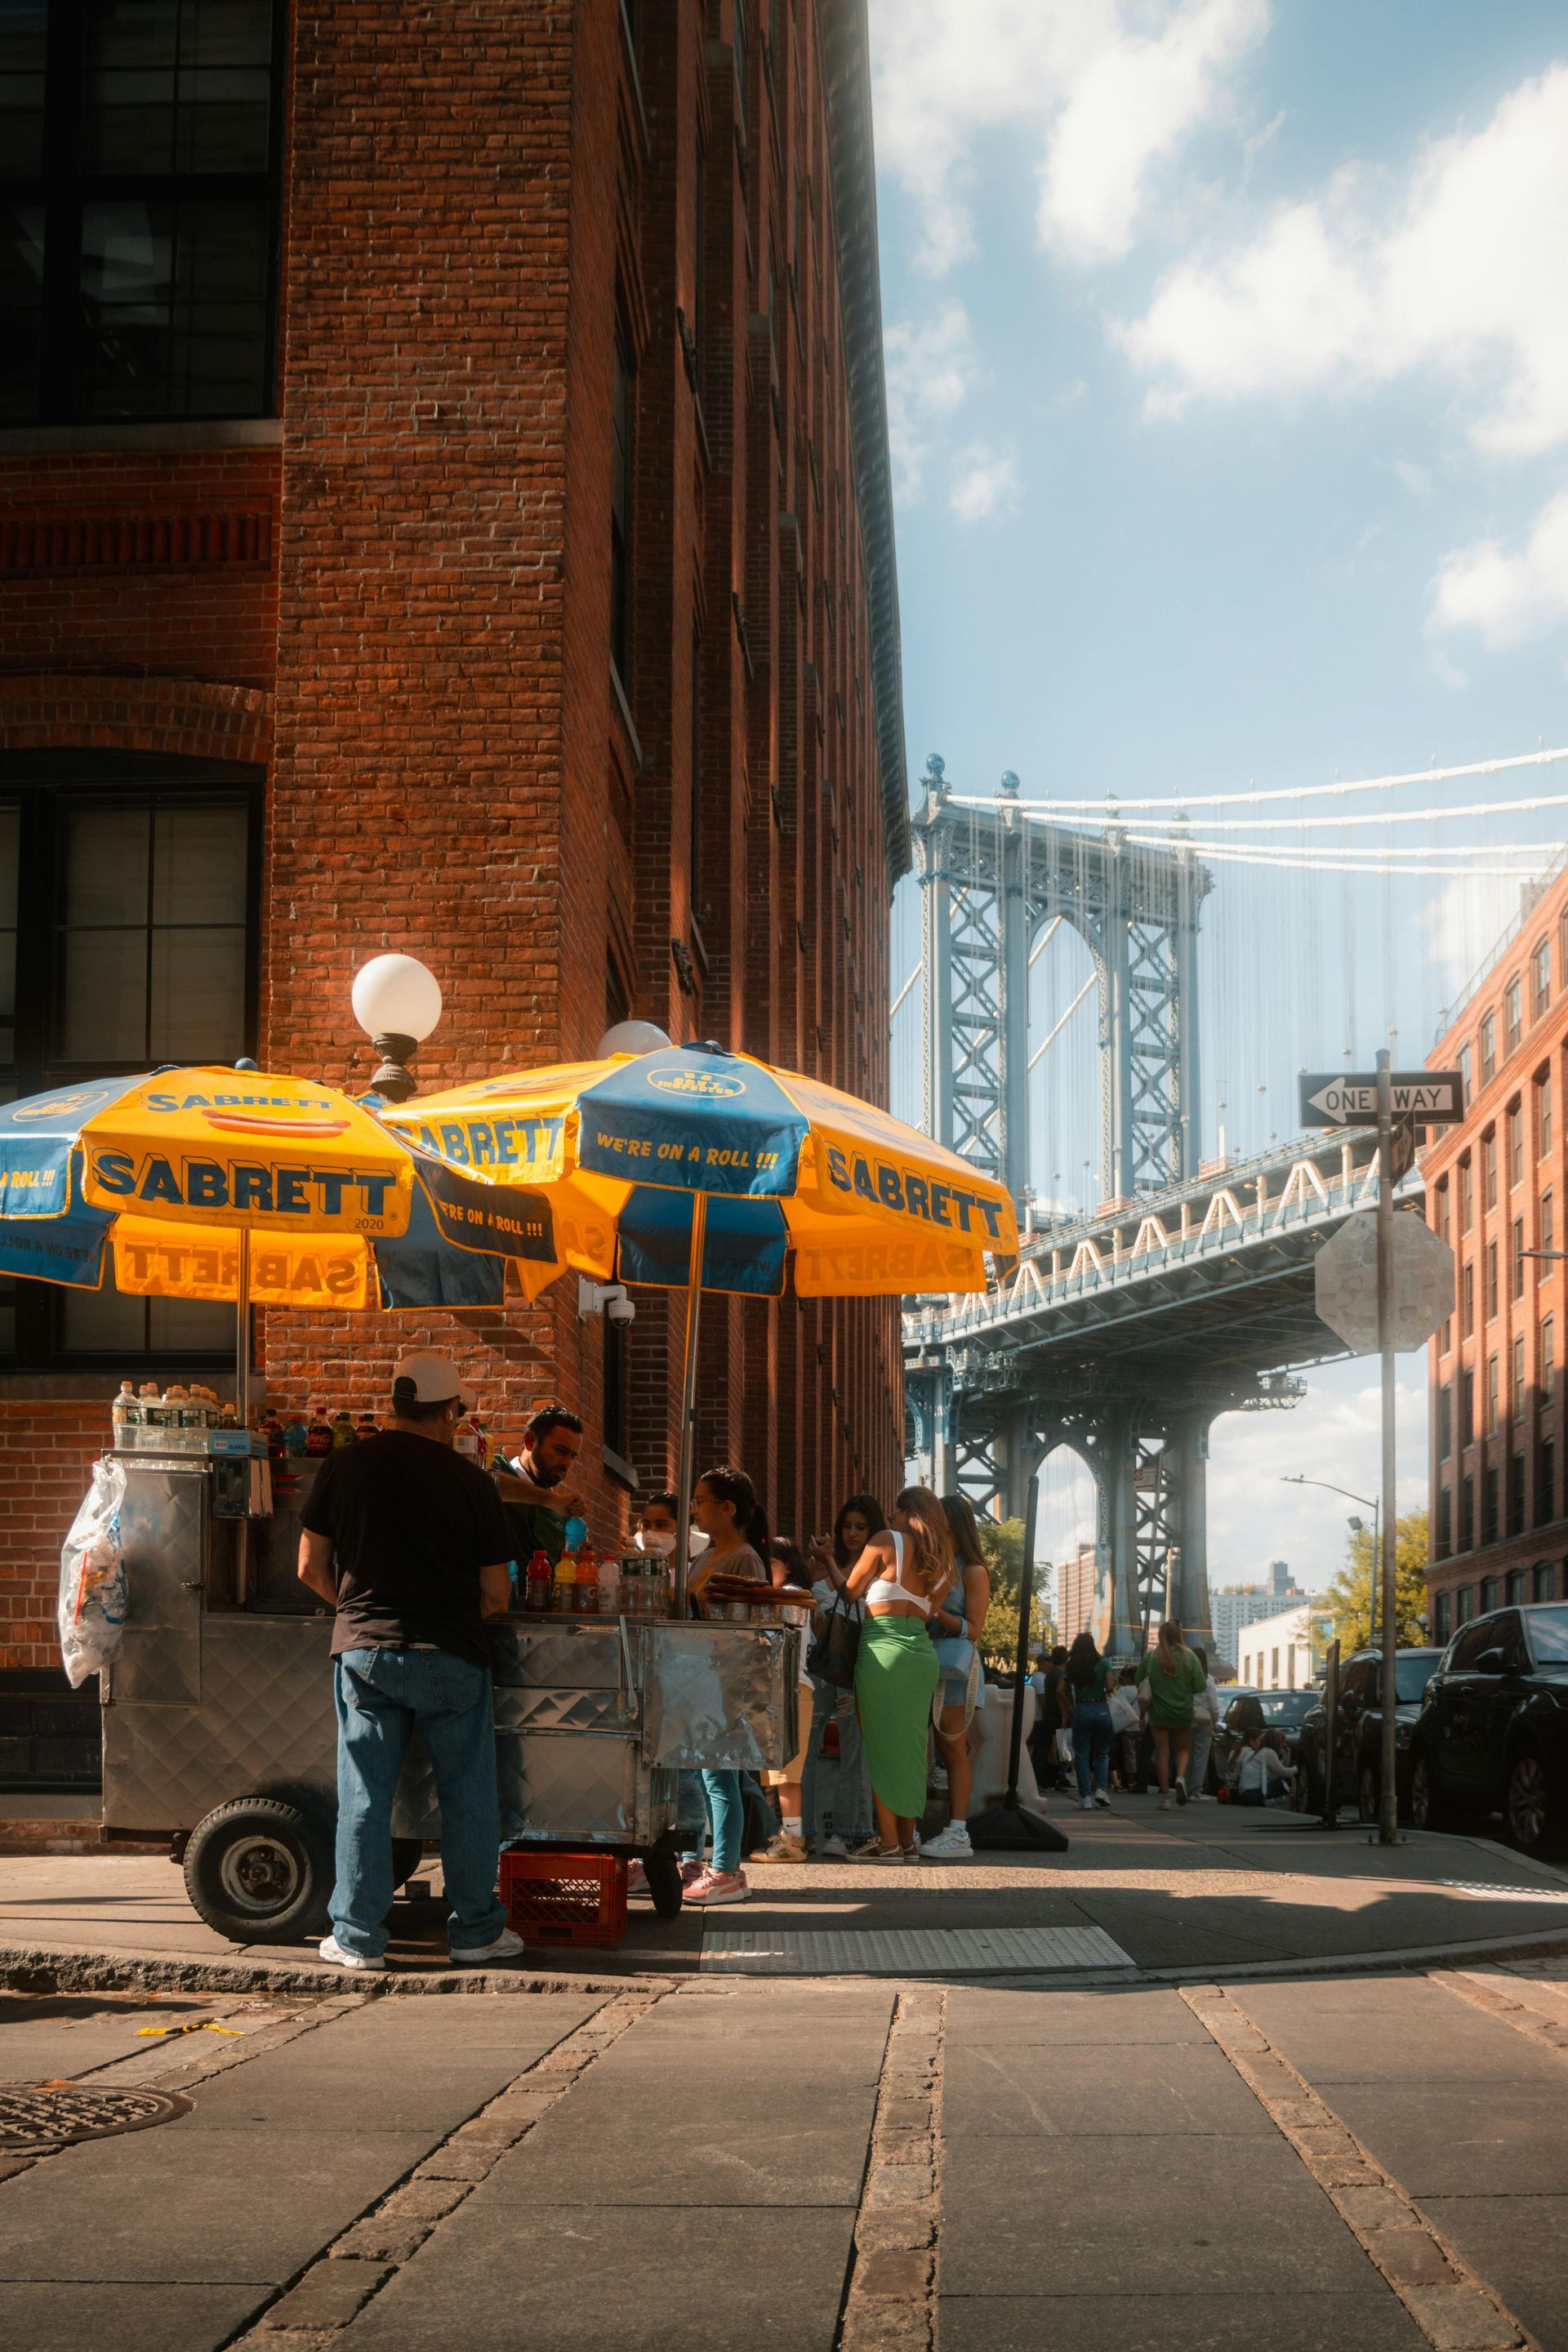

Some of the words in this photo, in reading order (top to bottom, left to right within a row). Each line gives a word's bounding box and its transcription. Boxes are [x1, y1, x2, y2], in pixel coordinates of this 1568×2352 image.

[140, 1092, 335, 1111] SABRETT
[1325, 1090, 1372, 1111] ONE
[1393, 1088, 1442, 1108] WAY
[597, 1132, 652, 1157] WE'RE
[657, 1143, 684, 1160] ON
[688, 1146, 700, 1163] A
[705, 1147, 750, 1167] ROLL
[755, 1152, 778, 1169] !!!
[11, 1169, 40, 1189] ROLL
[92, 1147, 396, 1215] SABRETT
[824, 1140, 1003, 1238] SABRETT
[354, 1218, 384, 1230] 2020
[466, 1208, 483, 1226] ON
[496, 1214, 523, 1235] ROLL
[527, 1222, 543, 1237] !!!
